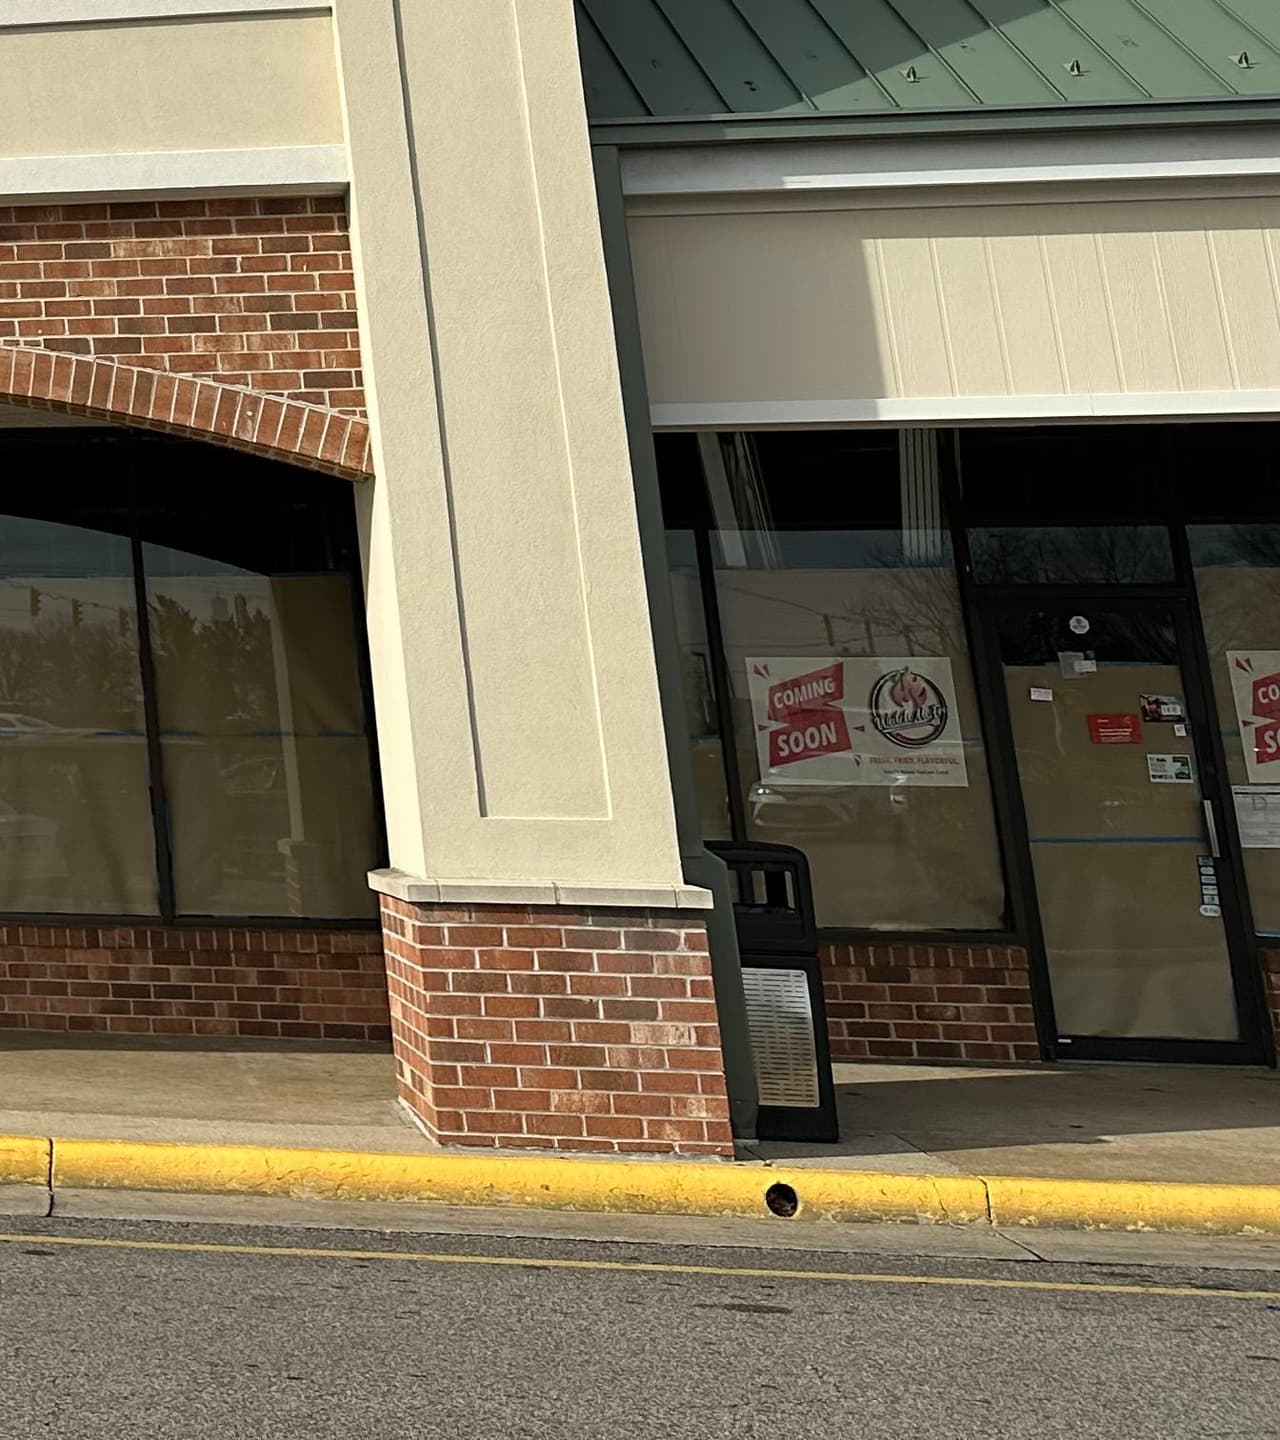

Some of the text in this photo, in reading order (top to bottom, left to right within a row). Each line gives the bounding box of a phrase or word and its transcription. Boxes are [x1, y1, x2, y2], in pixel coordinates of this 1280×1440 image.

[774, 678, 836, 709] COMING
[1258, 684, 1280, 704] CO
[777, 721, 838, 758] SOON
